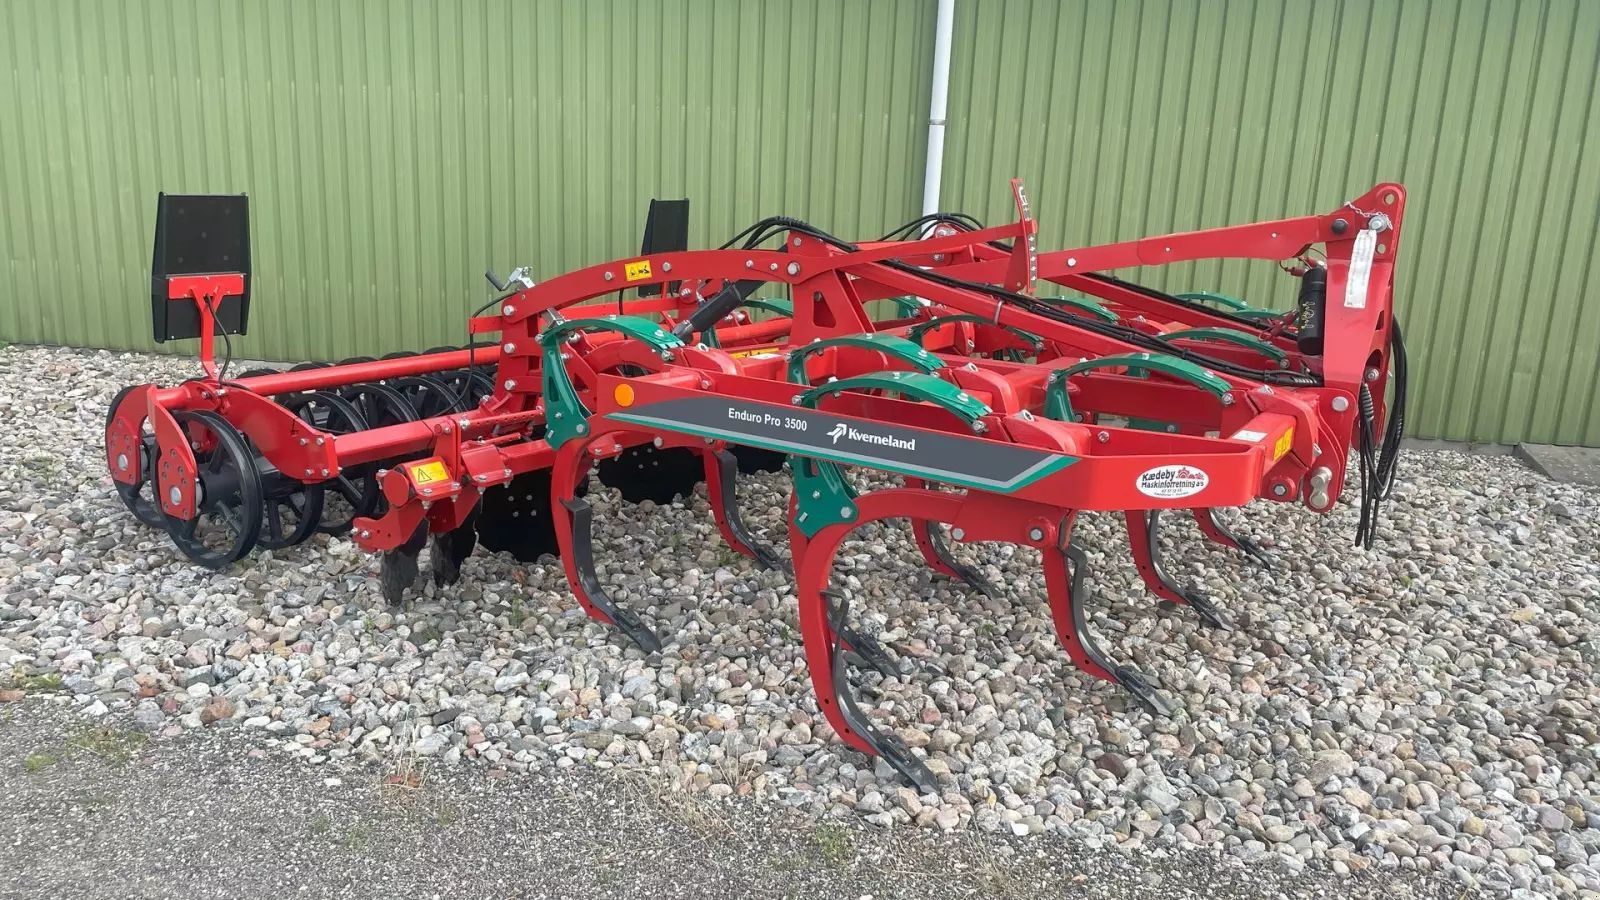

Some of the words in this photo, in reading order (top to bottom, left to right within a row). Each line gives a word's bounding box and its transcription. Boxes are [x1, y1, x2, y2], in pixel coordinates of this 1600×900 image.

[728, 408, 762, 424] Enduro
[764, 413, 781, 427] Pro
[784, 417, 807, 432] 3500
[848, 428, 916, 451] Kverneland
[1141, 480, 1196, 489] Maskinforretning
[1142, 469, 1176, 482] Kædeby
